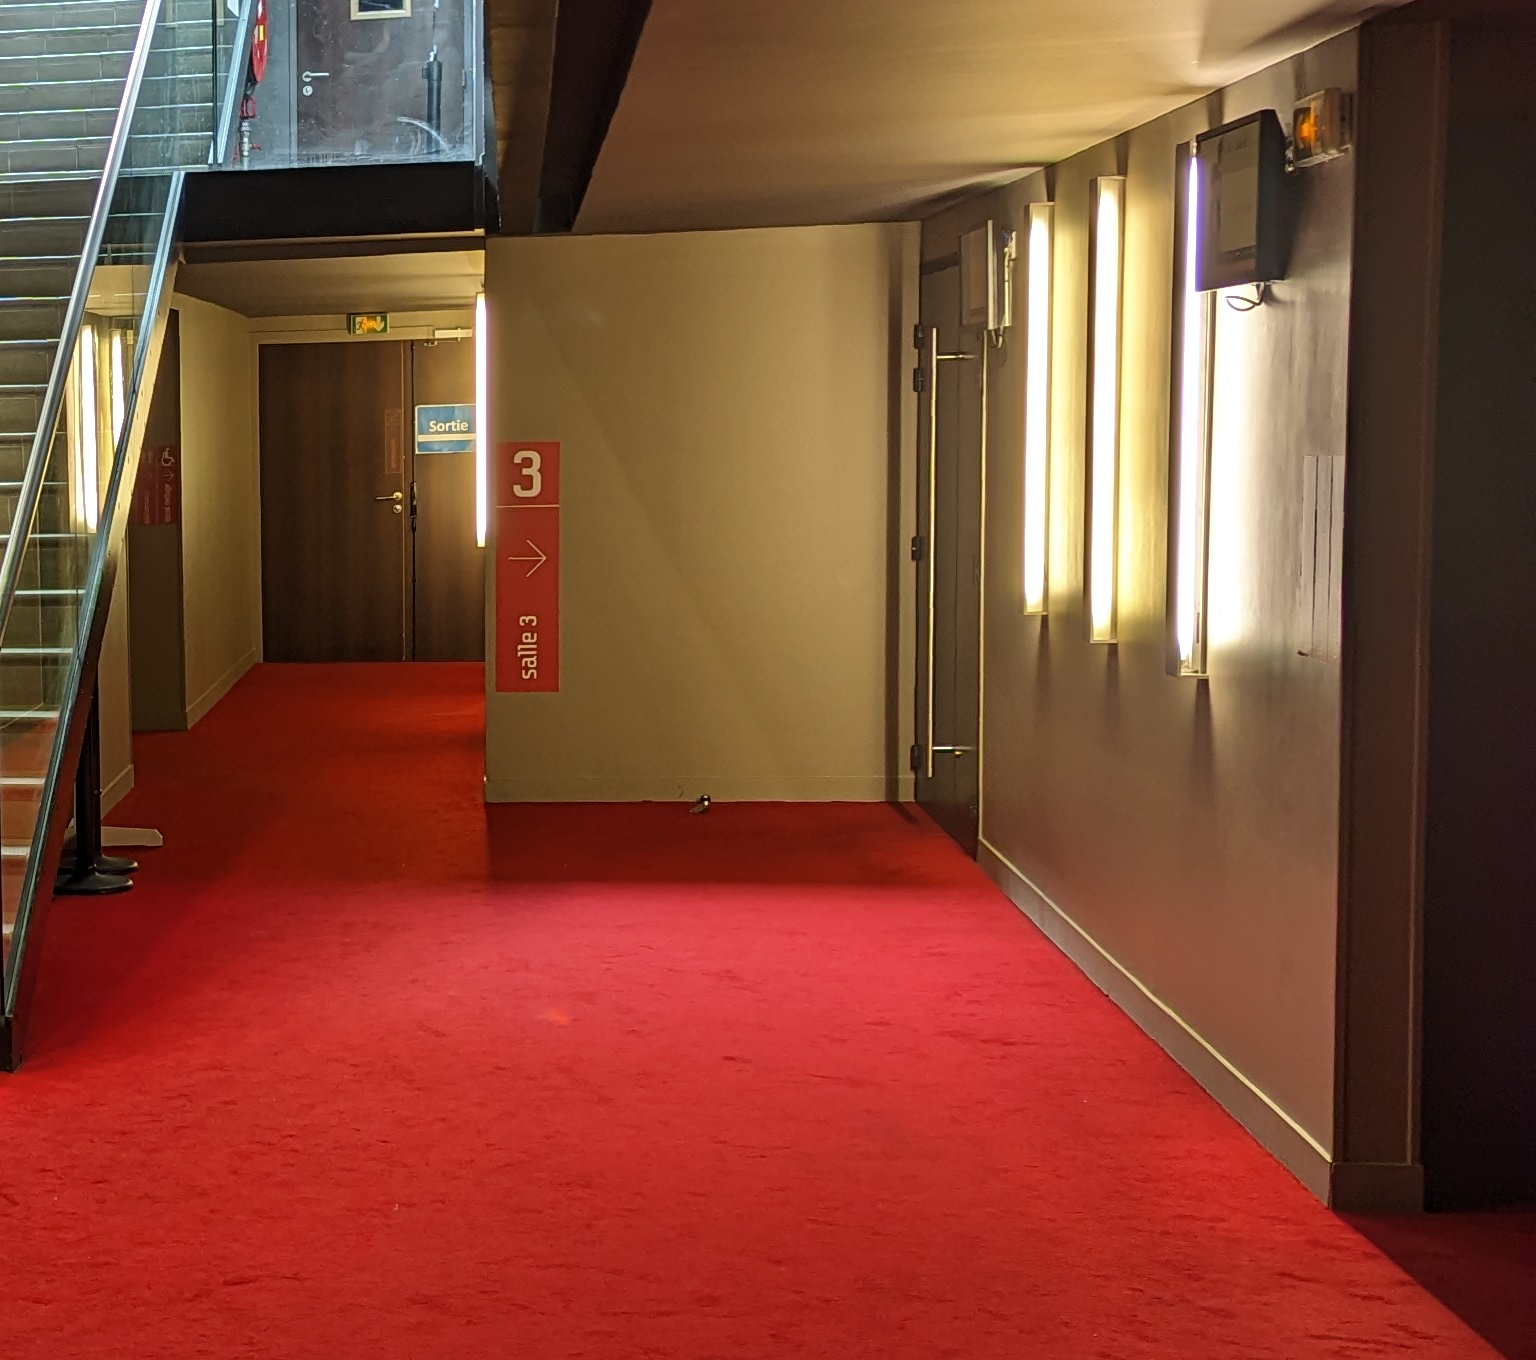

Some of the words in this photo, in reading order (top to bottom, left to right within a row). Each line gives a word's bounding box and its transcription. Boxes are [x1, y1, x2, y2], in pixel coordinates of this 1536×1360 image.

[429, 420, 469, 433] Sortie
[512, 450, 542, 498] 3
[519, 615, 537, 627] 3
[517, 632, 538, 680] salle
